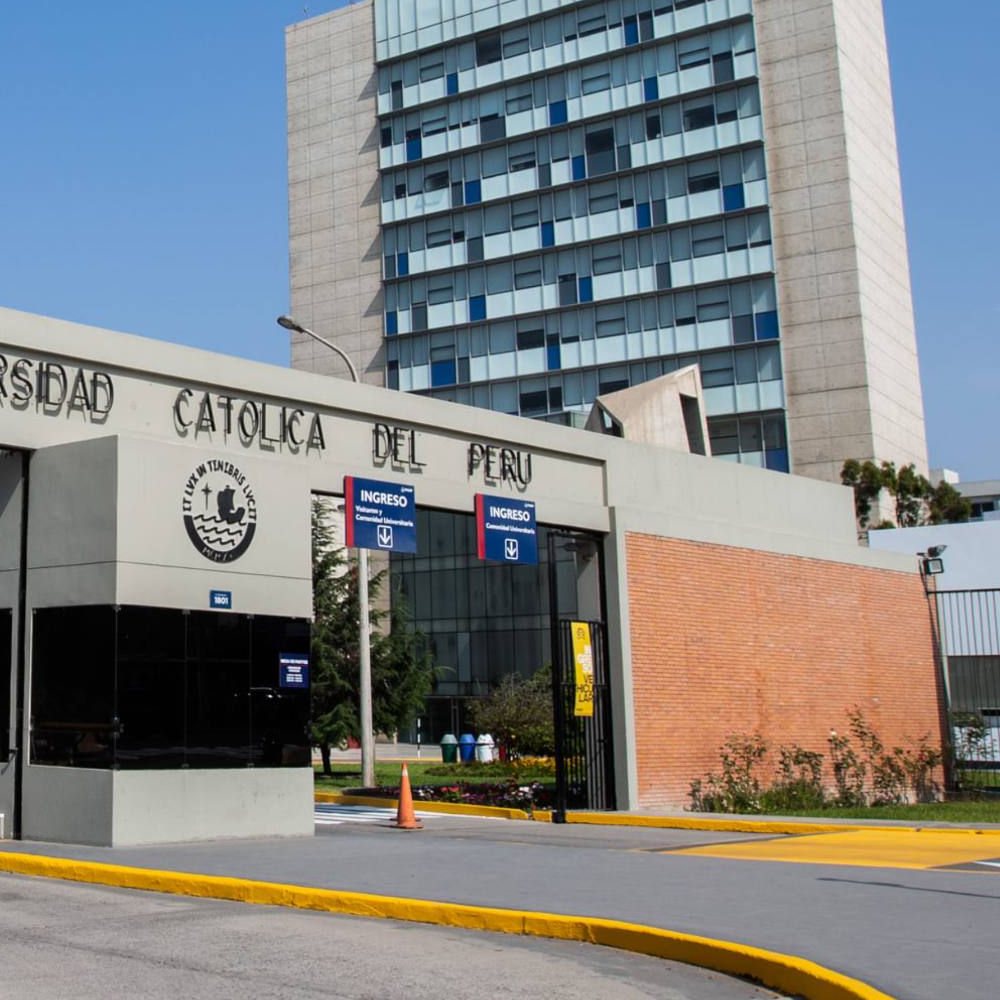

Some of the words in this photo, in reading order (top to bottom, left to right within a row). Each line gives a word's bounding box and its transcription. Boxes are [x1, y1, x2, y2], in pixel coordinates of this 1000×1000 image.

[174, 388, 326, 450] CATOLICA
[373, 422, 427, 467] DEL
[468, 442, 533, 485] PERU
[360, 489, 408, 508] INGRESO
[355, 514, 383, 523] Comunidad
[384, 517, 414, 527] Universitaria
[490, 506, 531, 522] INGRESO
